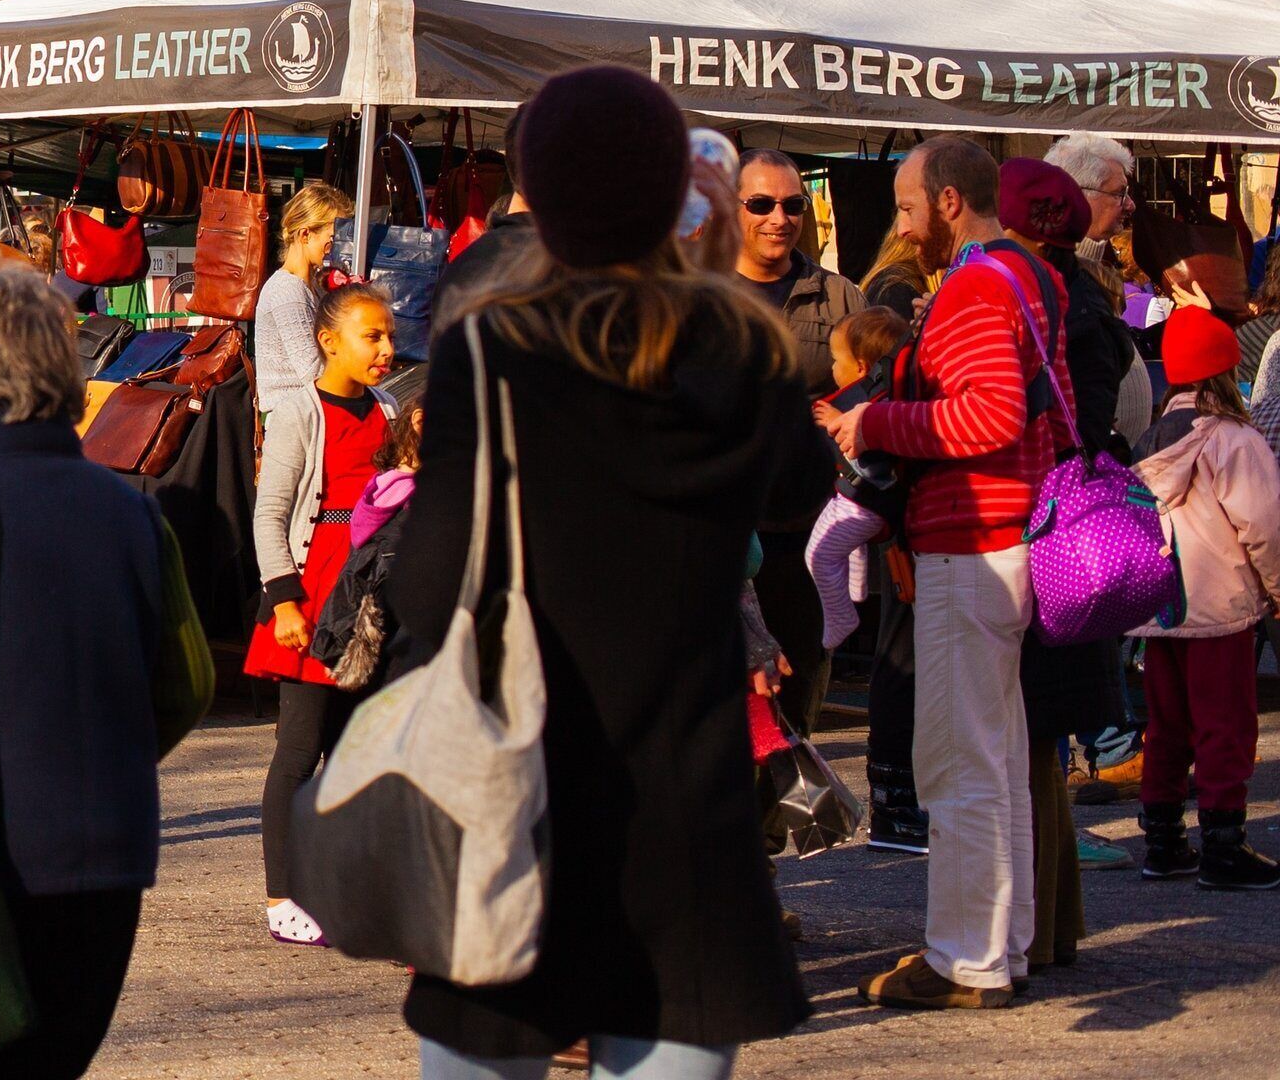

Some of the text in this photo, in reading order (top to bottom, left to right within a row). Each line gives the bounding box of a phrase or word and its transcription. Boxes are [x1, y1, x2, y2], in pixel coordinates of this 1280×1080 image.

[26, 36, 106, 87] BERG
[115, 27, 252, 80] LEATHER
[649, 36, 1212, 110] HENK BERG LEATHER
